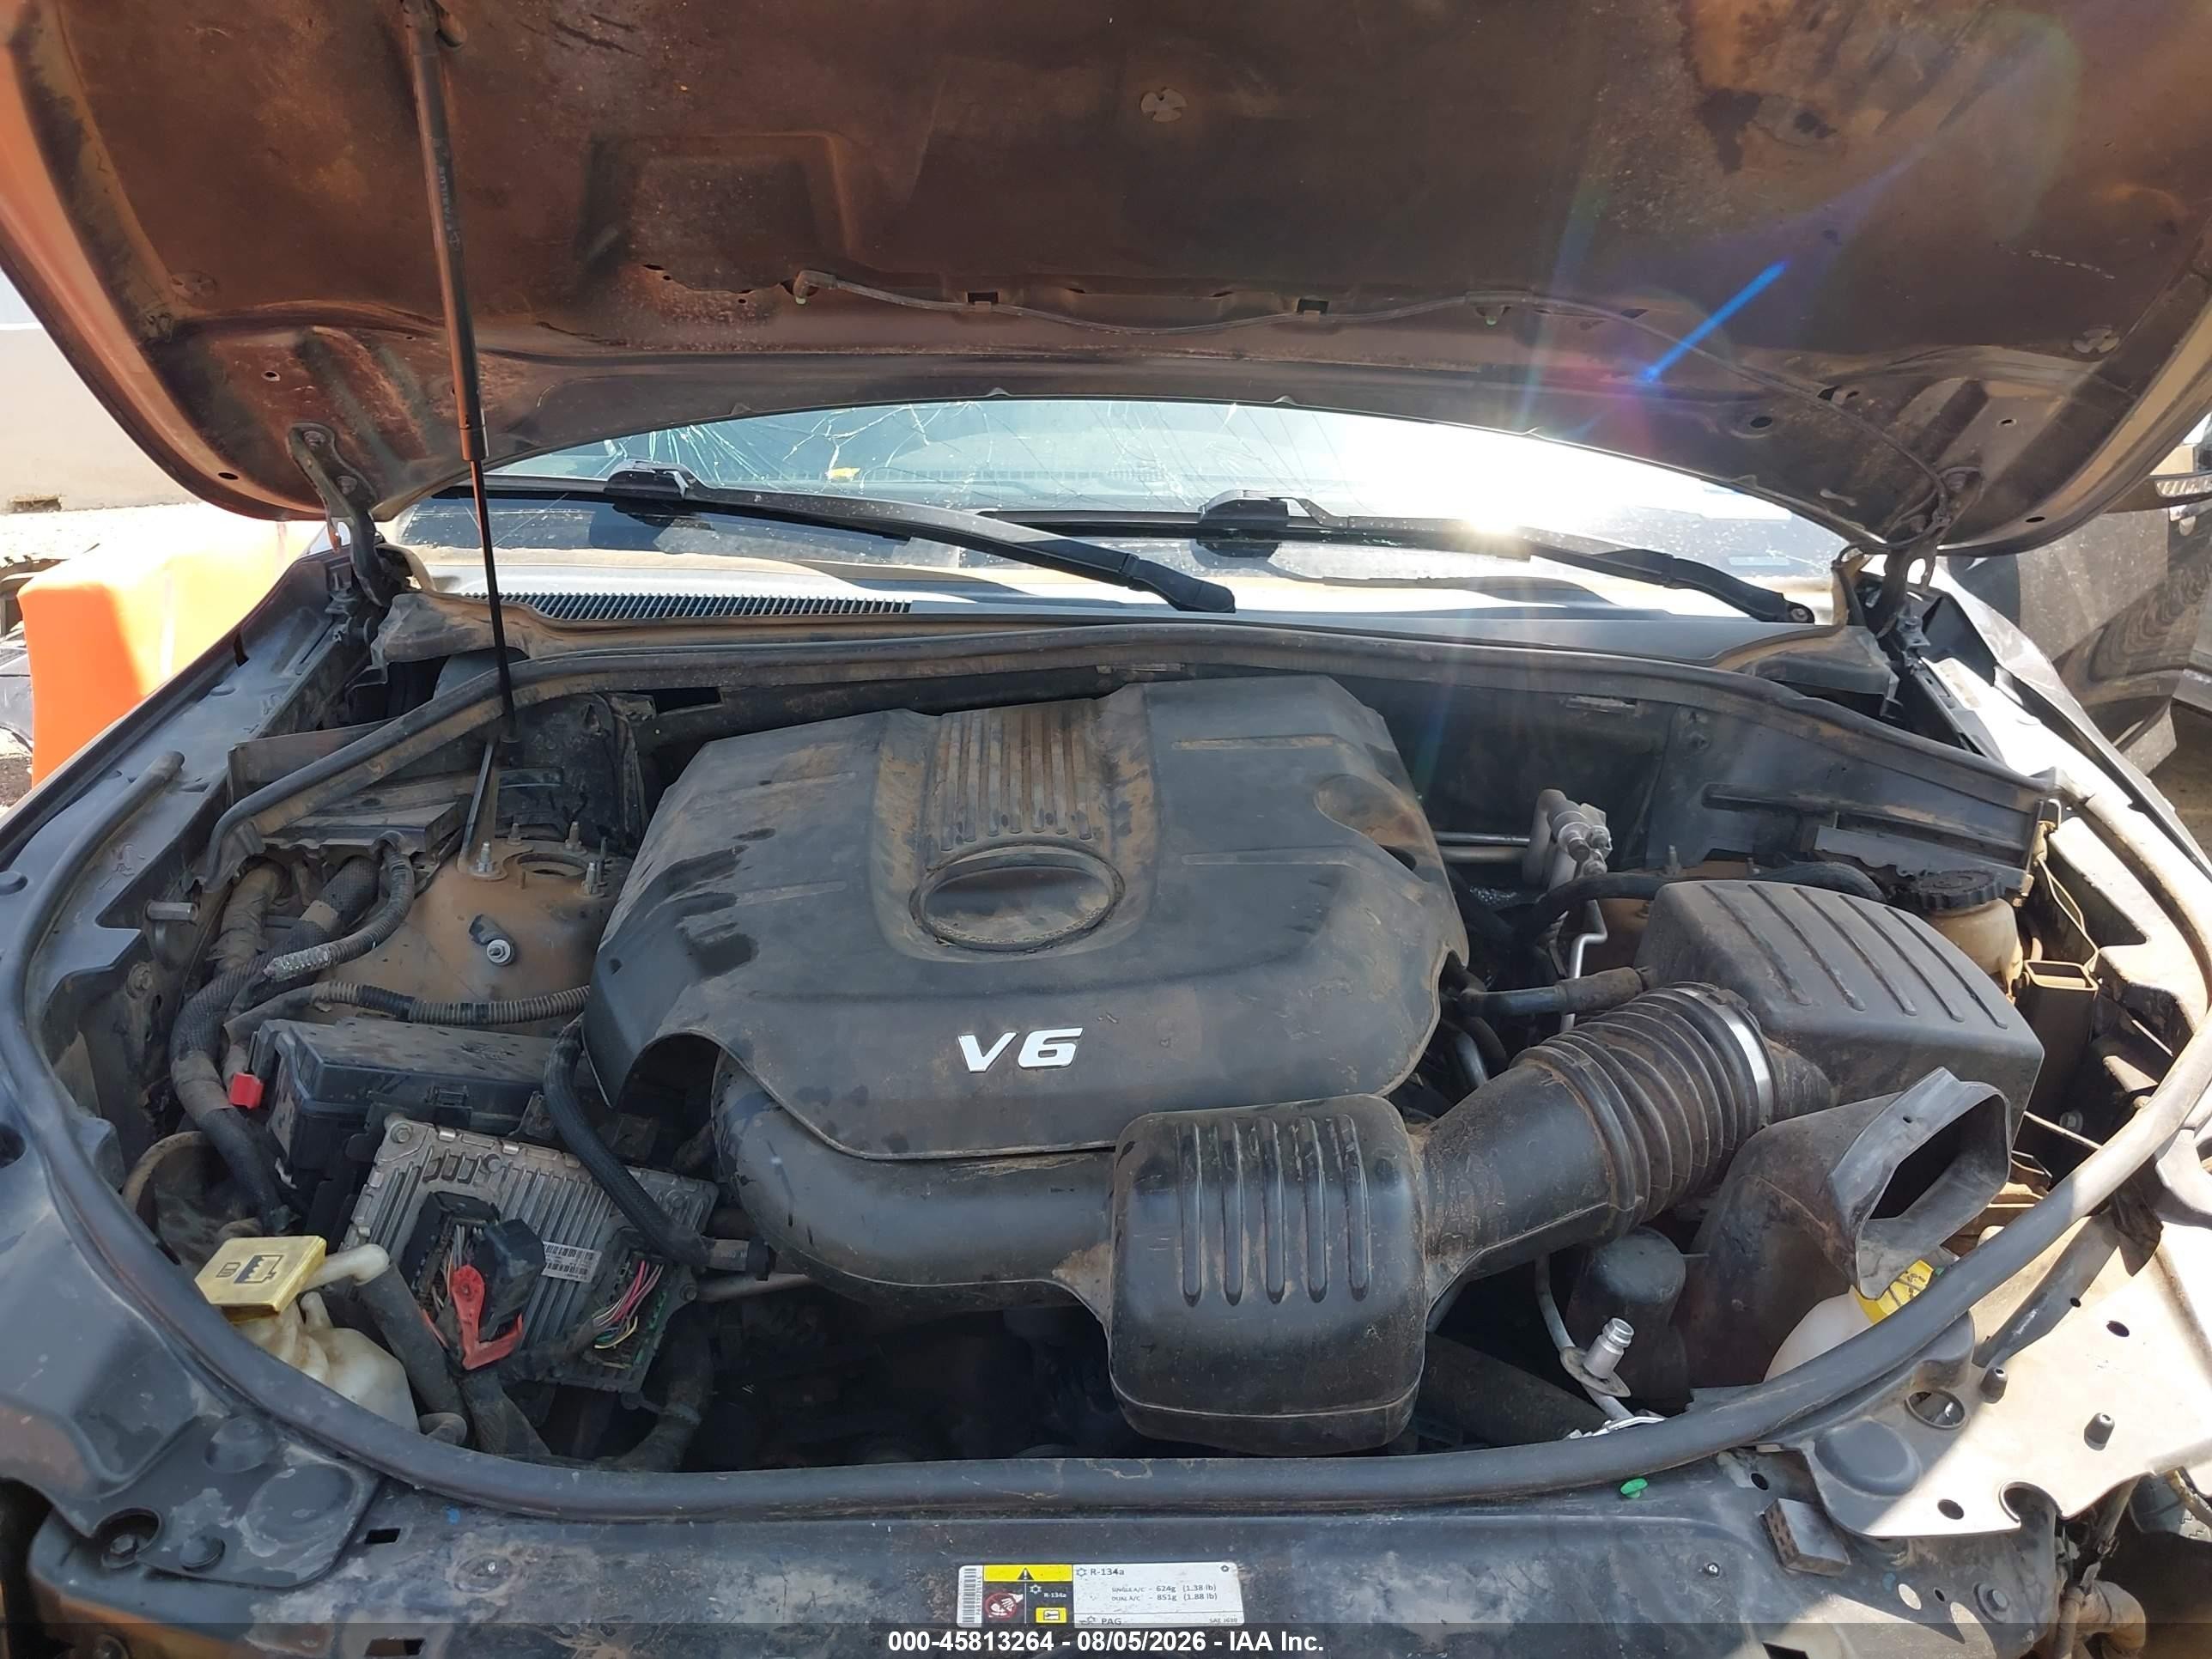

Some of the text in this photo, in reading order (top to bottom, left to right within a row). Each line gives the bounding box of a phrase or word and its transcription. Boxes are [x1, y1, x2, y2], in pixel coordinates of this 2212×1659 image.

[1023, 928, 1064, 942] FILTER
[958, 1027, 1083, 1073] V6
[1205, 1583, 1217, 1592] lb)
